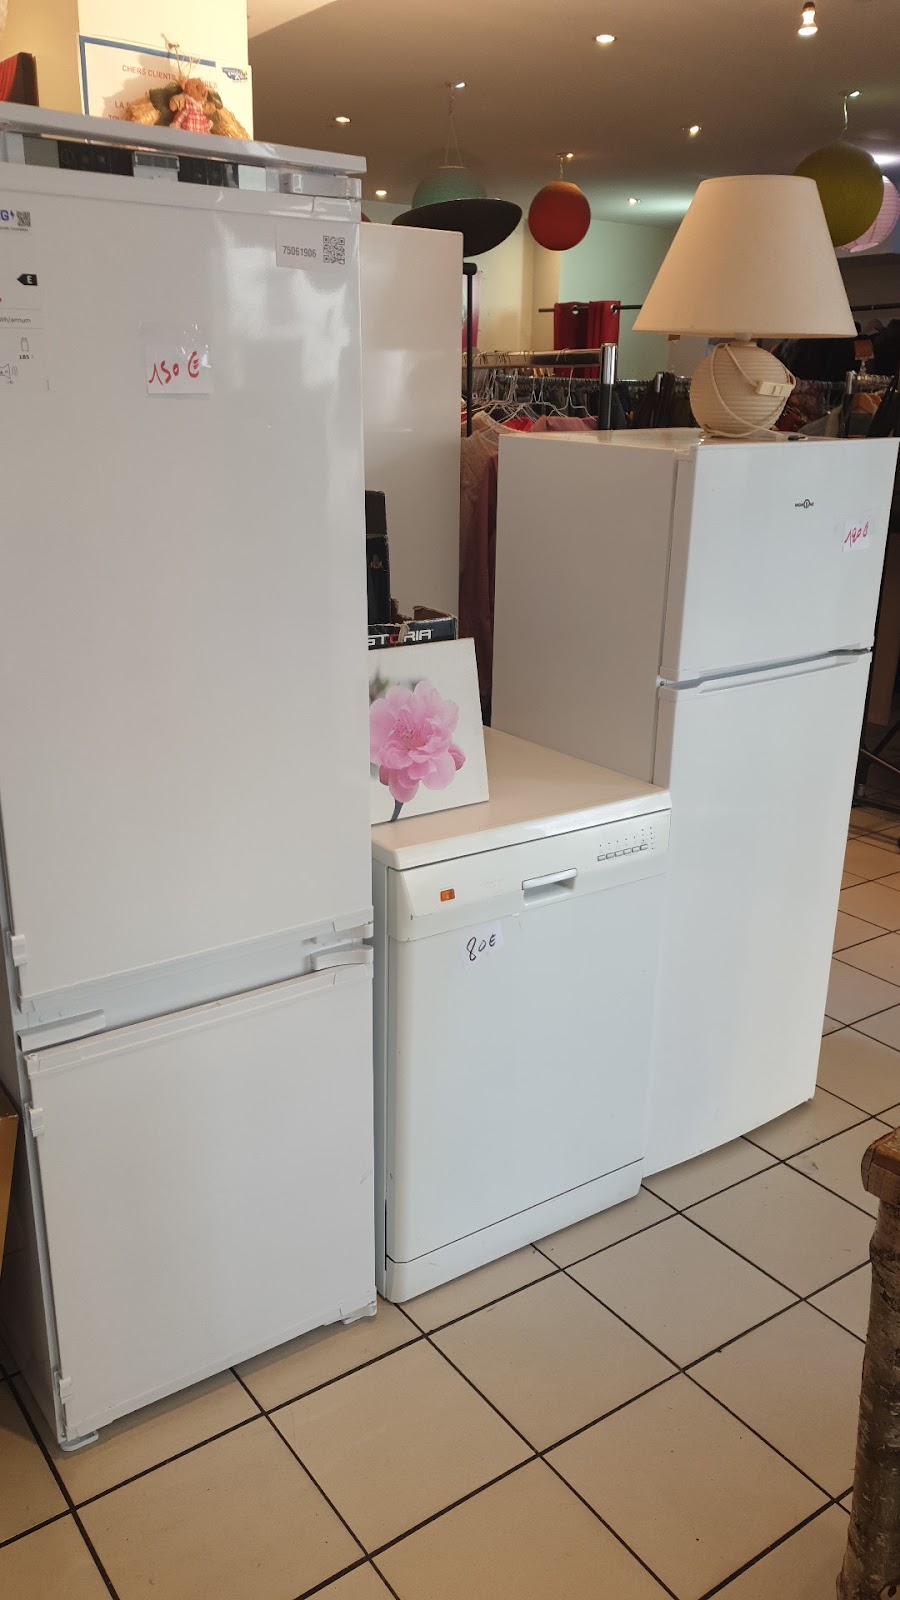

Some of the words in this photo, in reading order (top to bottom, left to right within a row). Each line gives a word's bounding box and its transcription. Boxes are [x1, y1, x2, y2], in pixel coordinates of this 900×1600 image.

[122, 64, 147, 76] CHERS
[148, 69, 176, 80] CLIENTS
[282, 245, 317, 258] 75061906
